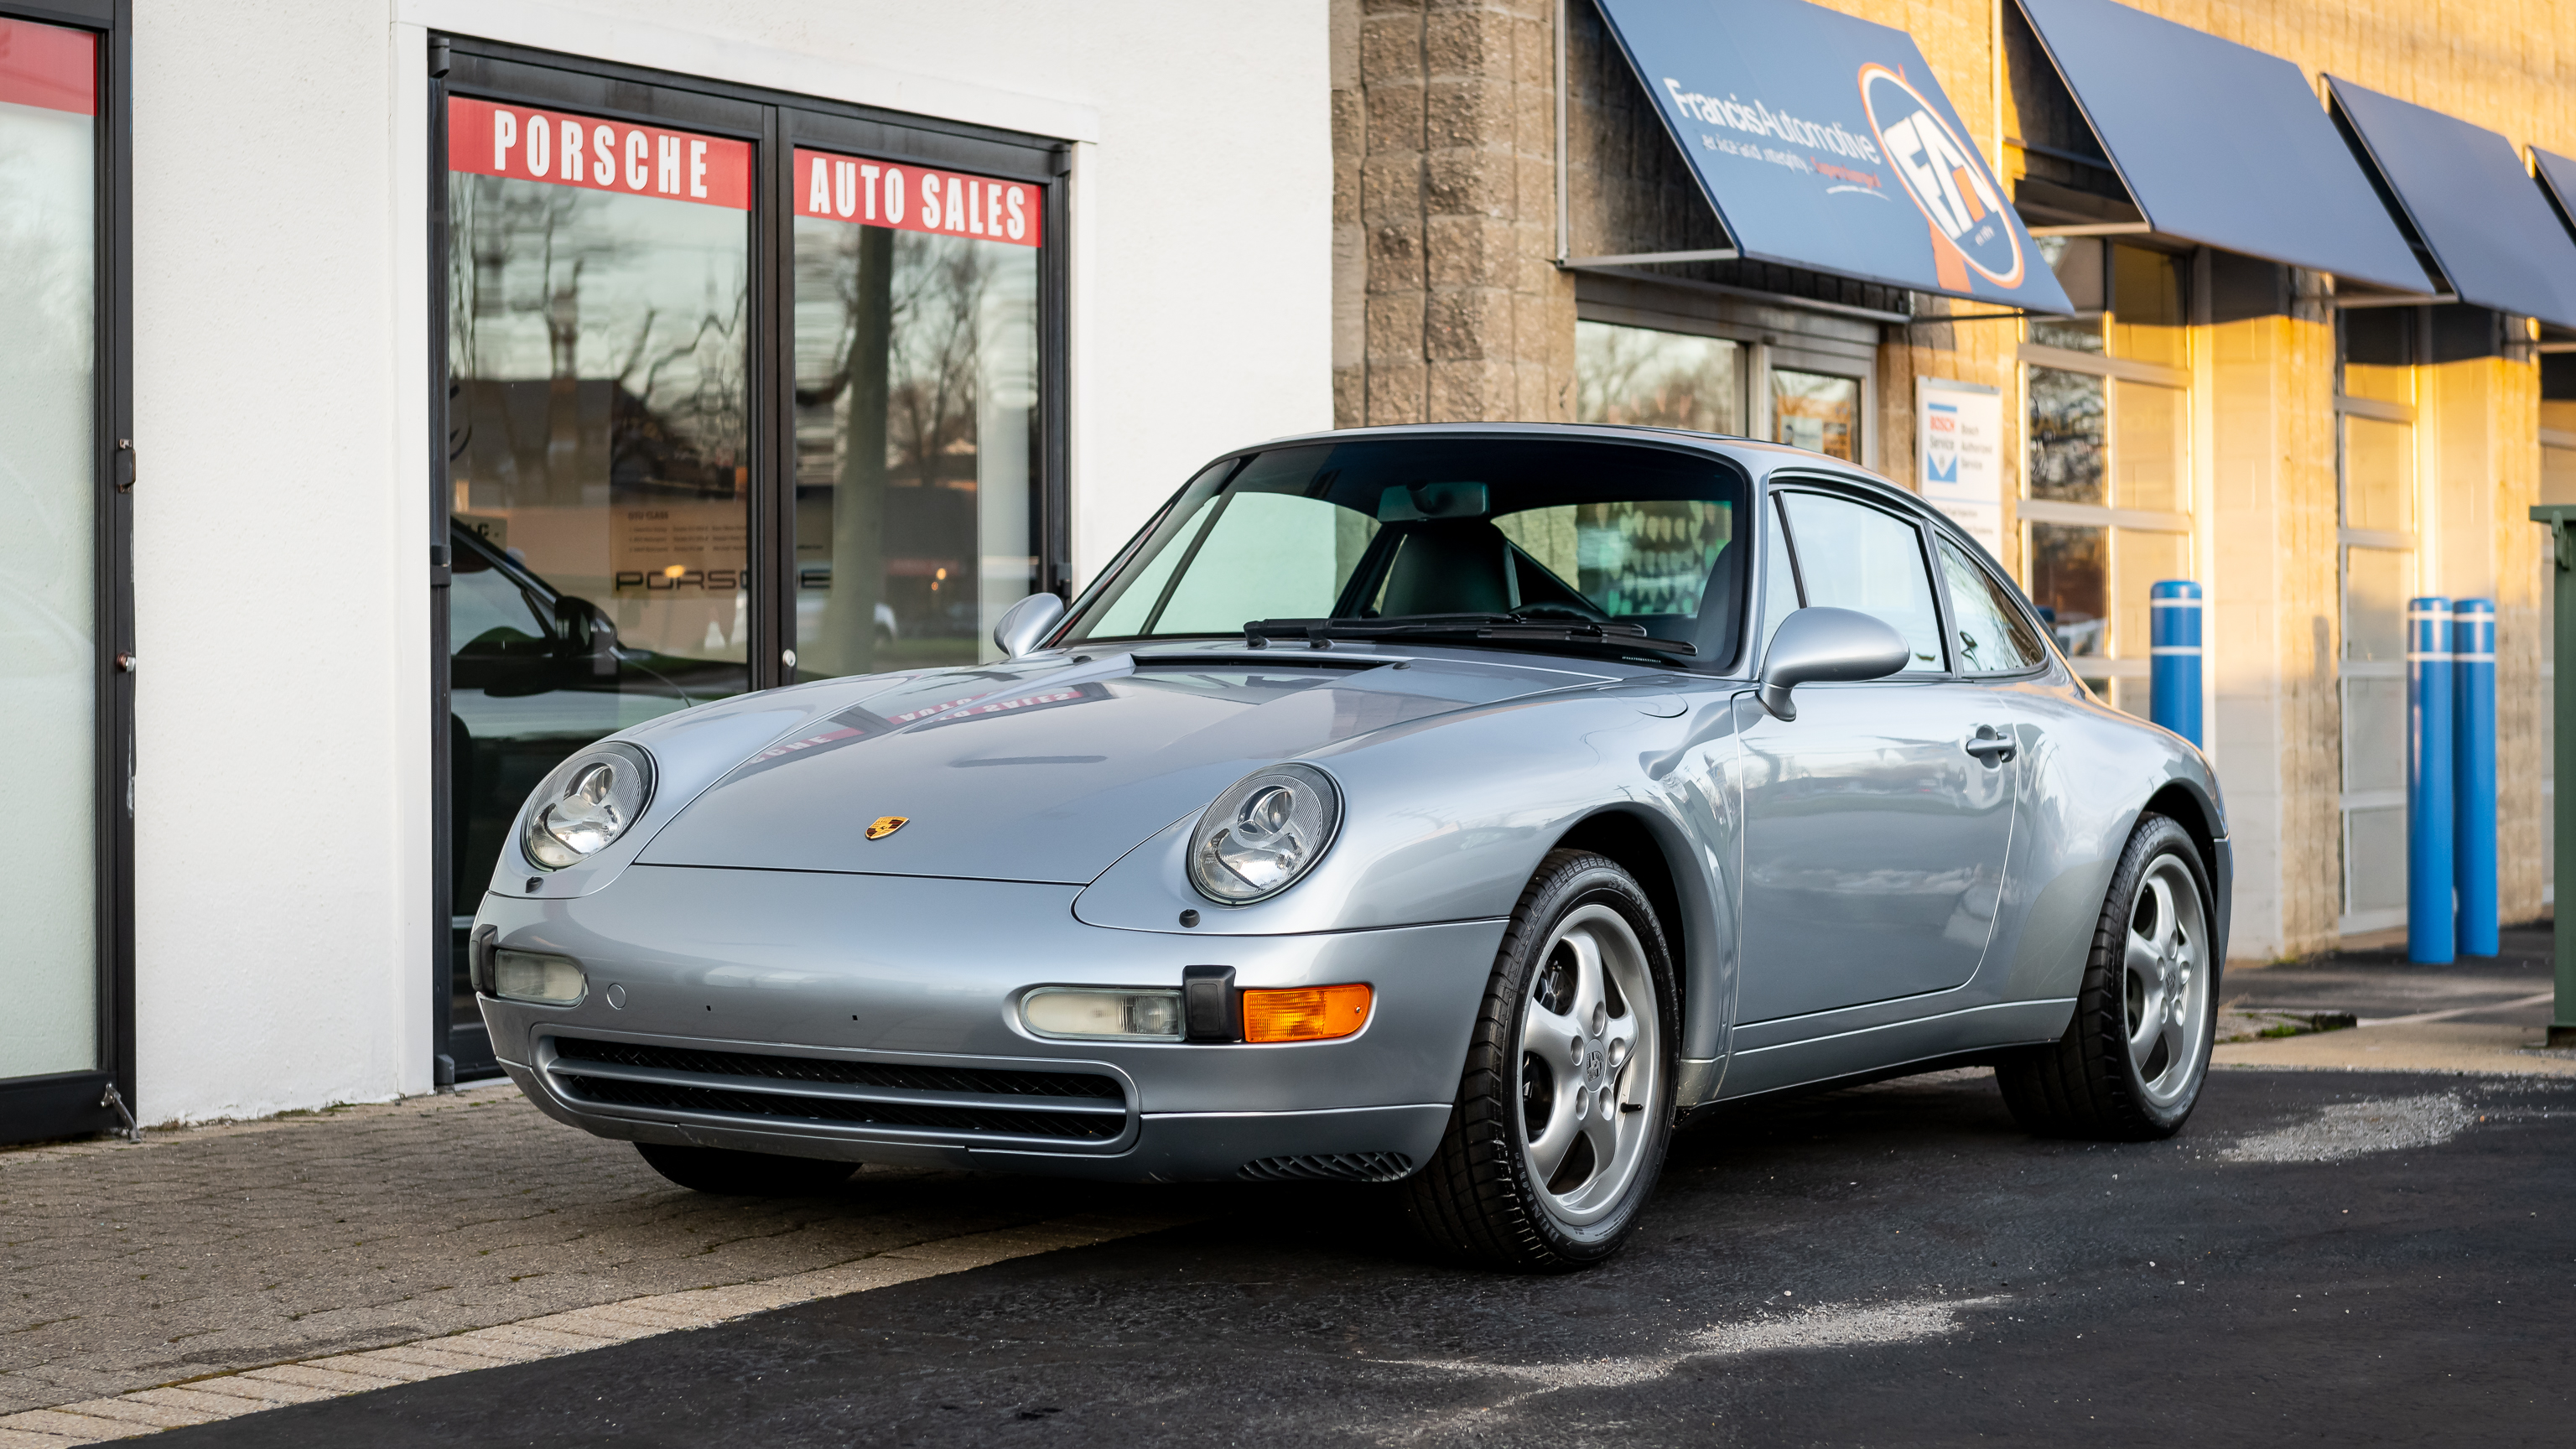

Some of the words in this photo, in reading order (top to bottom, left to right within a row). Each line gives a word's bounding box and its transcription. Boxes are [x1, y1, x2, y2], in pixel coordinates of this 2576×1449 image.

[494, 109, 709, 199] PORSCHE
[808, 157, 905, 225] AUTO
[922, 177, 1026, 241] SALES
[1930, 415, 1955, 434] BOSCH
[1929, 434, 1955, 451] Service
[615, 569, 831, 591] PORSE
